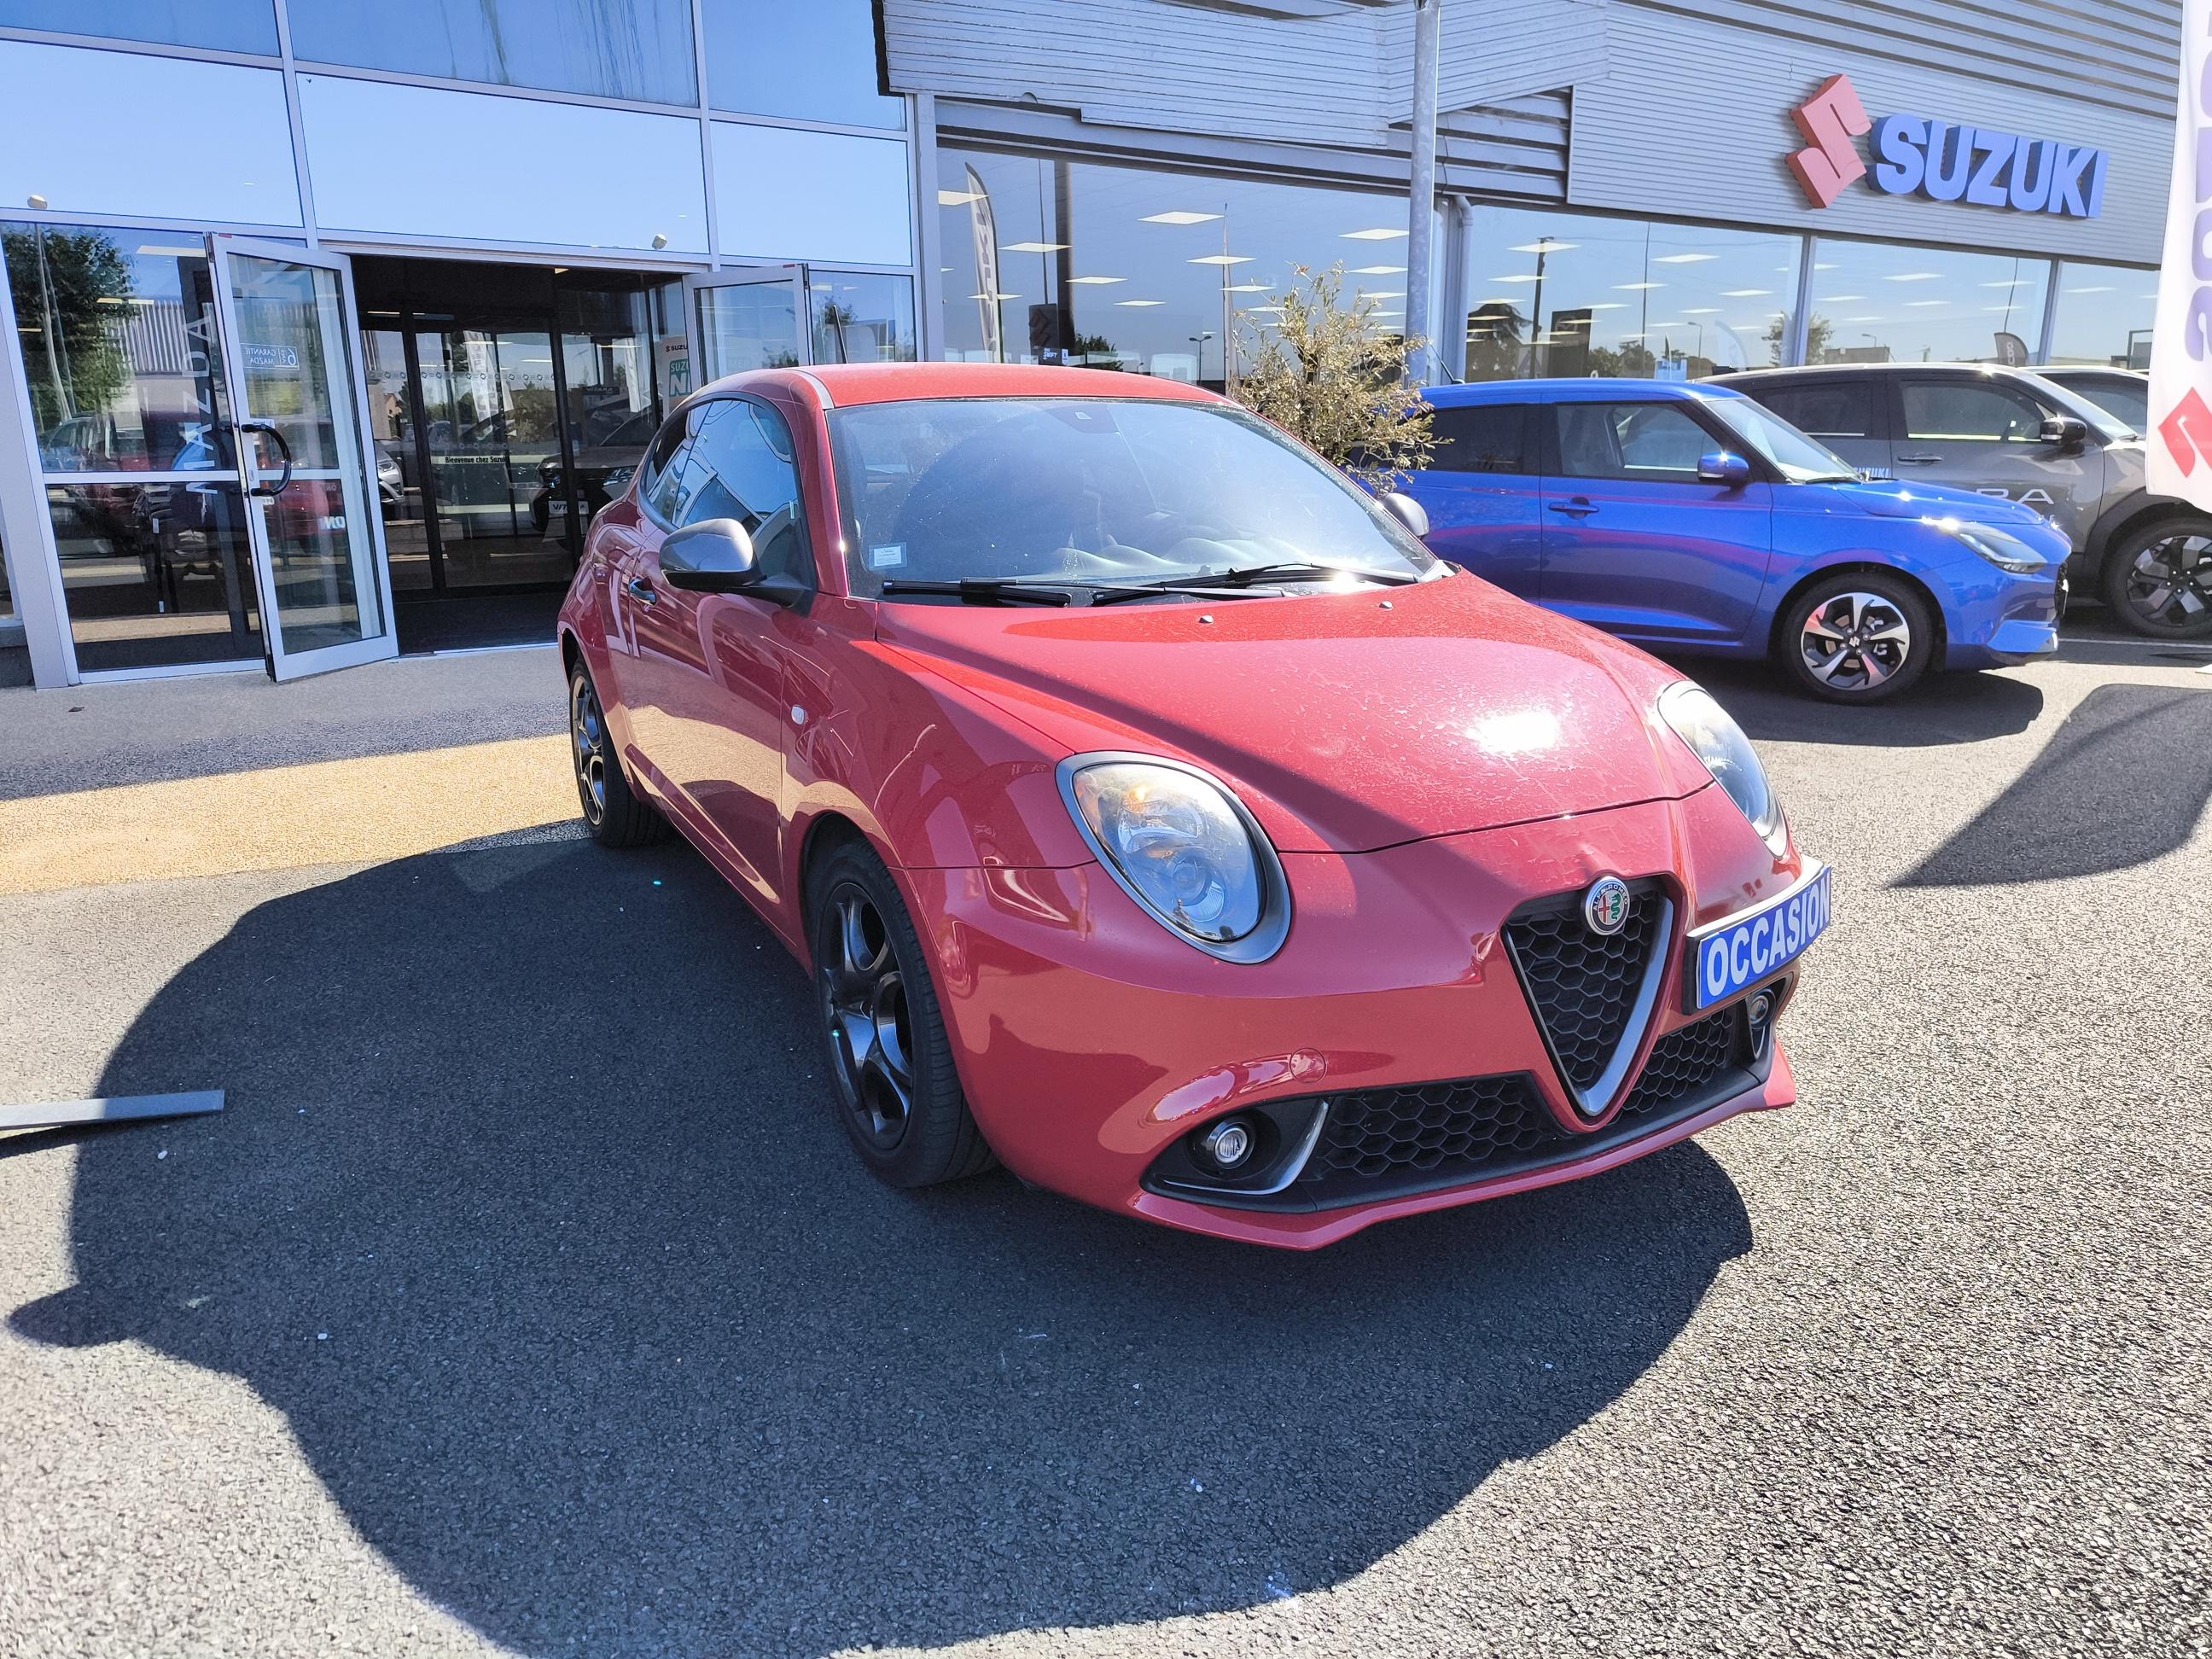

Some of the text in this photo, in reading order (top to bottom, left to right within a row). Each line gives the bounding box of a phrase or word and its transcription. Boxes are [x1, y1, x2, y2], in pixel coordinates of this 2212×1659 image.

[1873, 114, 2110, 219] SUZUKI
[182, 317, 218, 494] MAZDA
[670, 361, 689, 372] SUZ
[1592, 884, 1629, 911] ALFA ROMEO
[1707, 870, 1830, 997] OCCASION
